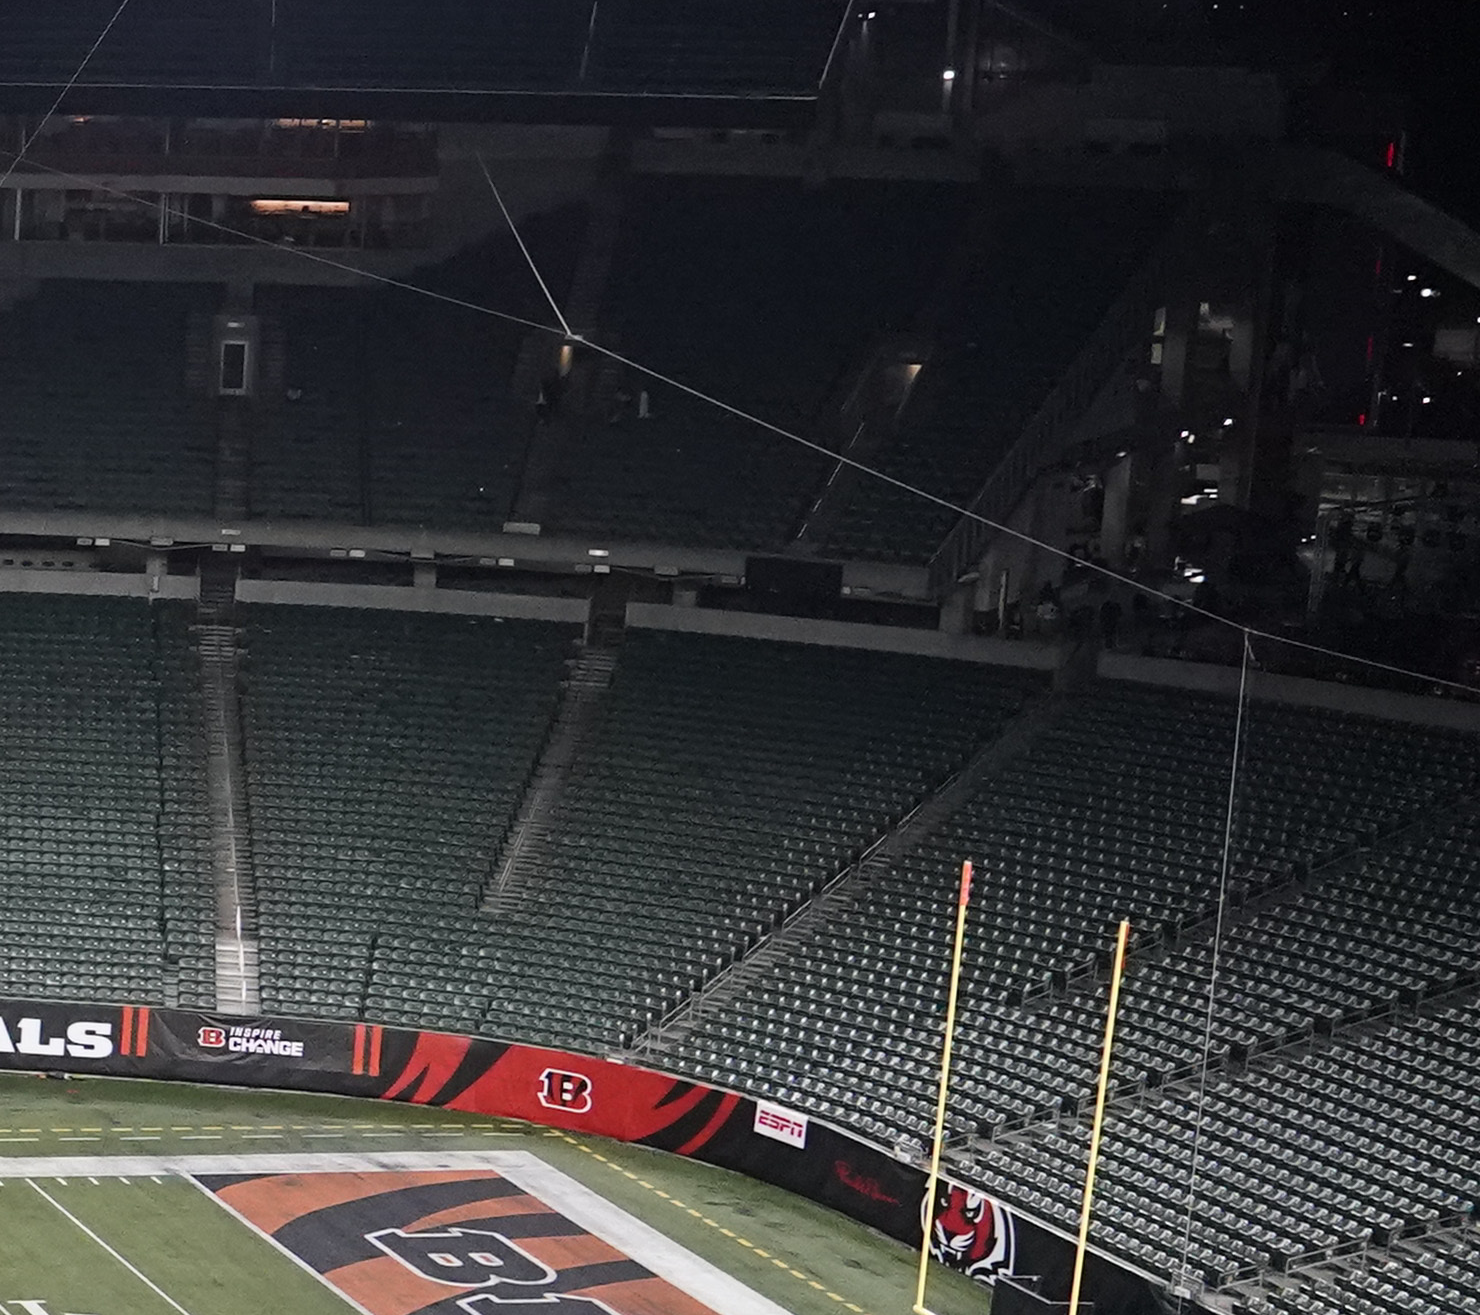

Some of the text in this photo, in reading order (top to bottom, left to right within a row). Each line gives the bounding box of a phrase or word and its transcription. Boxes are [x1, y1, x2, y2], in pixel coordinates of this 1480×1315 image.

[230, 1026, 282, 1040] INSPIRE
[228, 1037, 304, 1057] CHANGE
[758, 1109, 803, 1138] ESPN
